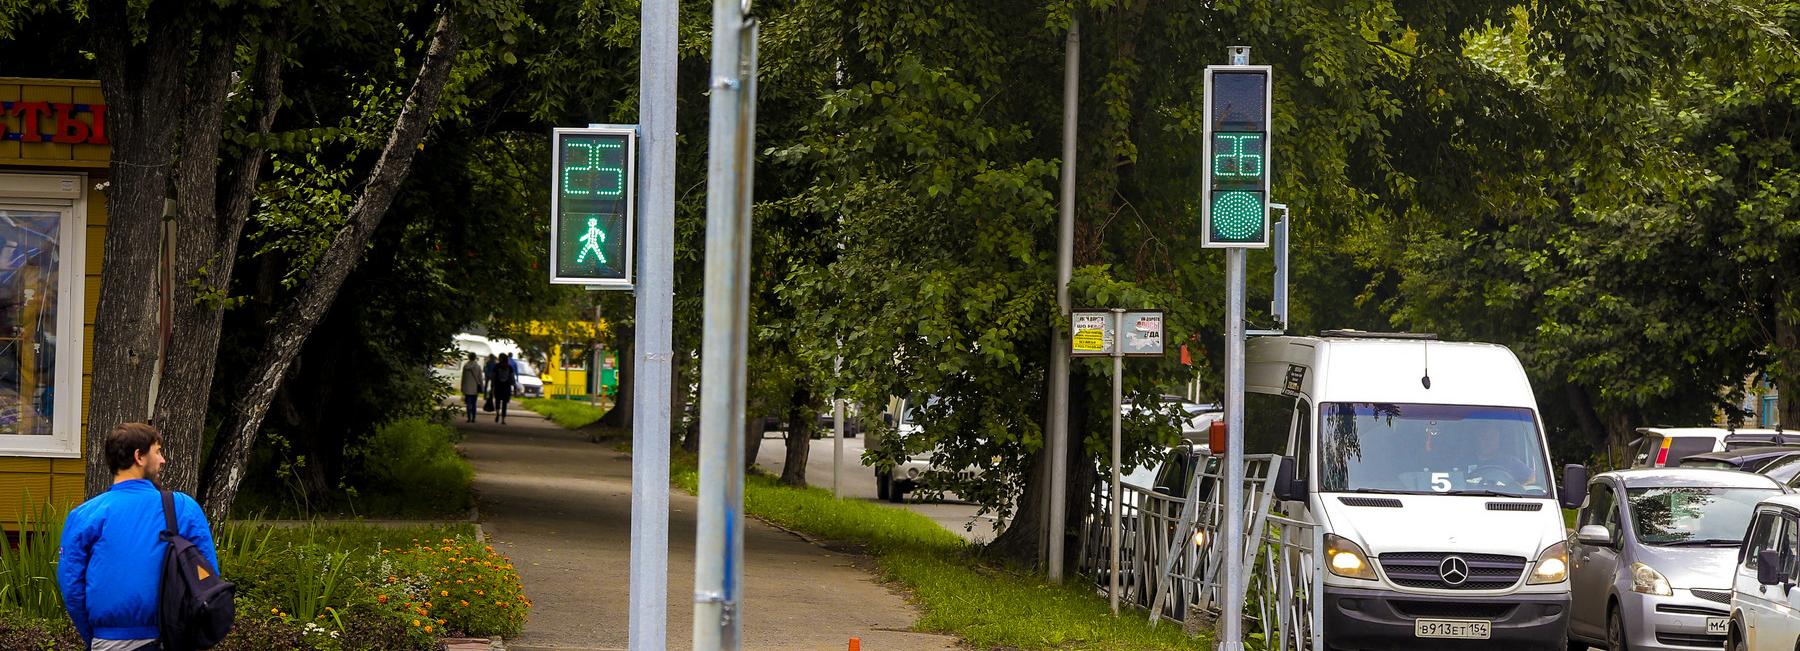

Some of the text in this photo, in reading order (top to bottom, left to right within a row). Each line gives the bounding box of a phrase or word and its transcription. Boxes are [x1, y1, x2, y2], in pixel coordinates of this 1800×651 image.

[0, 101, 110, 144] ТЫ
[564, 143, 622, 195] 25
[1215, 135, 1261, 176] 26
[1431, 472, 1452, 493] 5
[1710, 619, 1730, 631] М4
